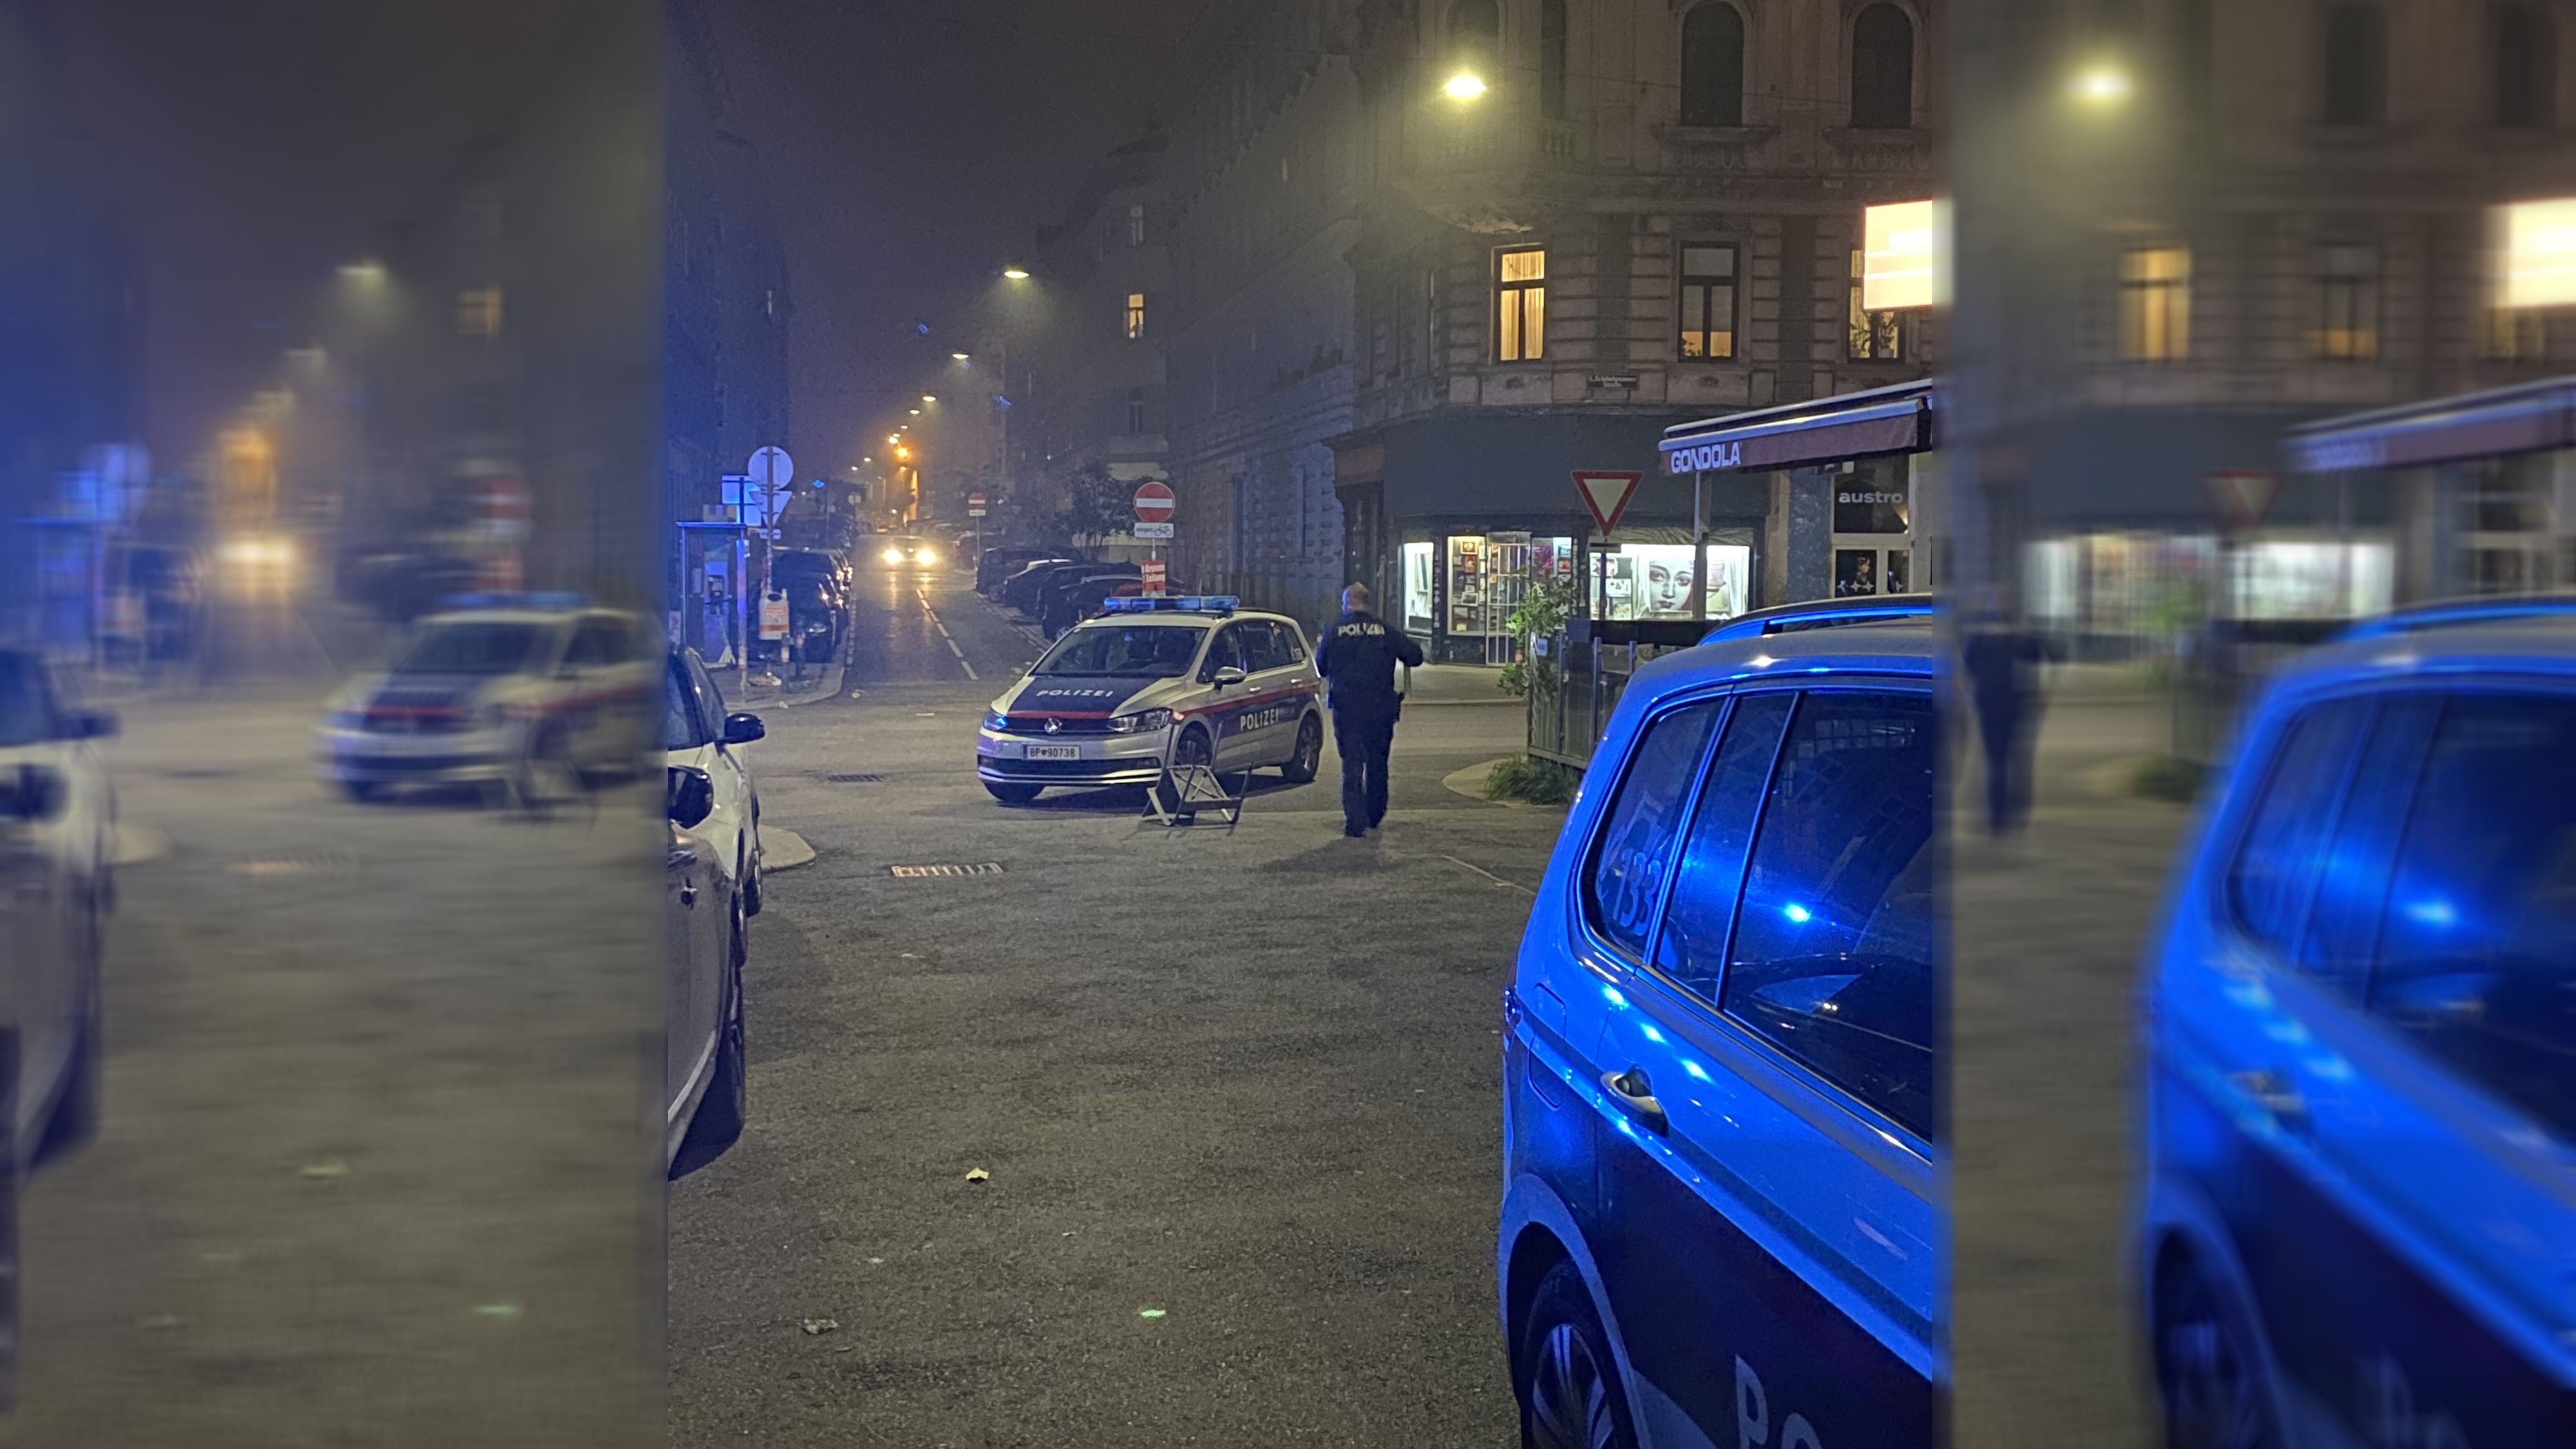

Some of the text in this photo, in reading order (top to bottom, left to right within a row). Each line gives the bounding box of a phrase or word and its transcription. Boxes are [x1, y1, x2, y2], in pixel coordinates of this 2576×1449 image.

[1671, 442, 1741, 473] GONDOLA
[1839, 491, 1903, 503] austro
[1036, 689, 1113, 697] POLIZEI
[1240, 708, 1278, 732] POLIZEI
[1030, 748, 1075, 758] BP 90738
[1613, 848, 1662, 936] 133
